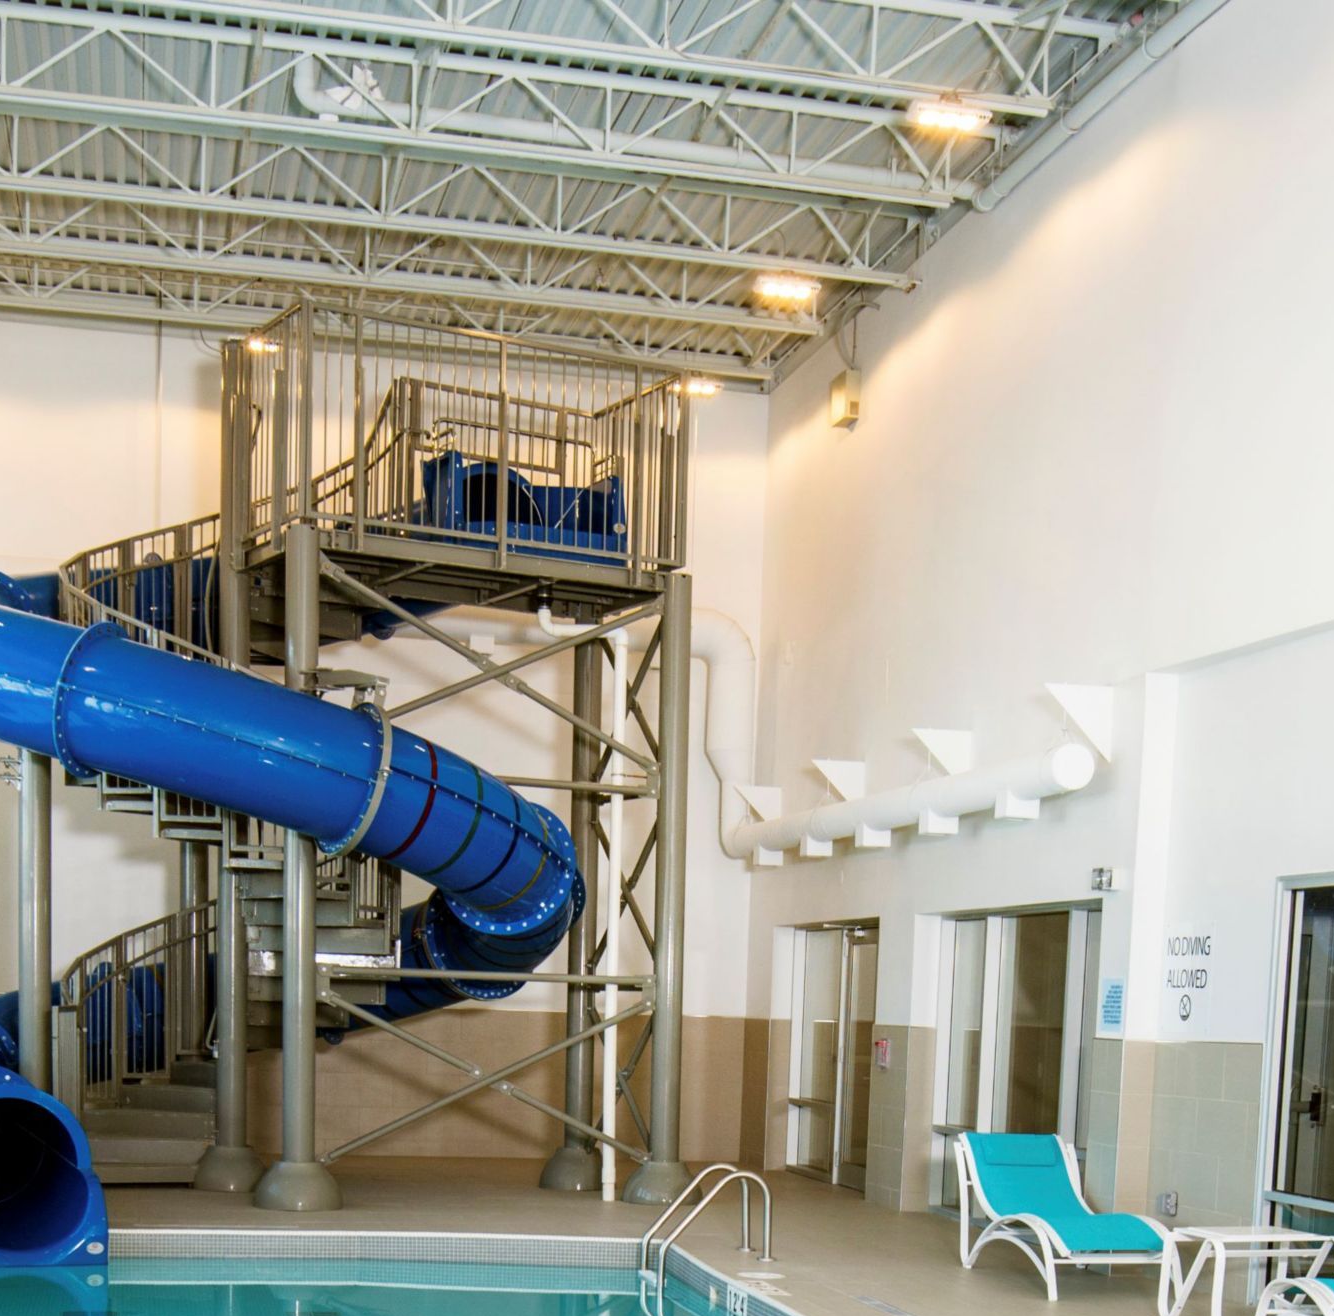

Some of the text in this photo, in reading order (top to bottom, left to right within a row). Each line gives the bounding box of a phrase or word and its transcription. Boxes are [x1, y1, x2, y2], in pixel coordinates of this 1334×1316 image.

[1167, 936, 1211, 956] NO DIVING
[1167, 969, 1208, 989] ALLOWED
